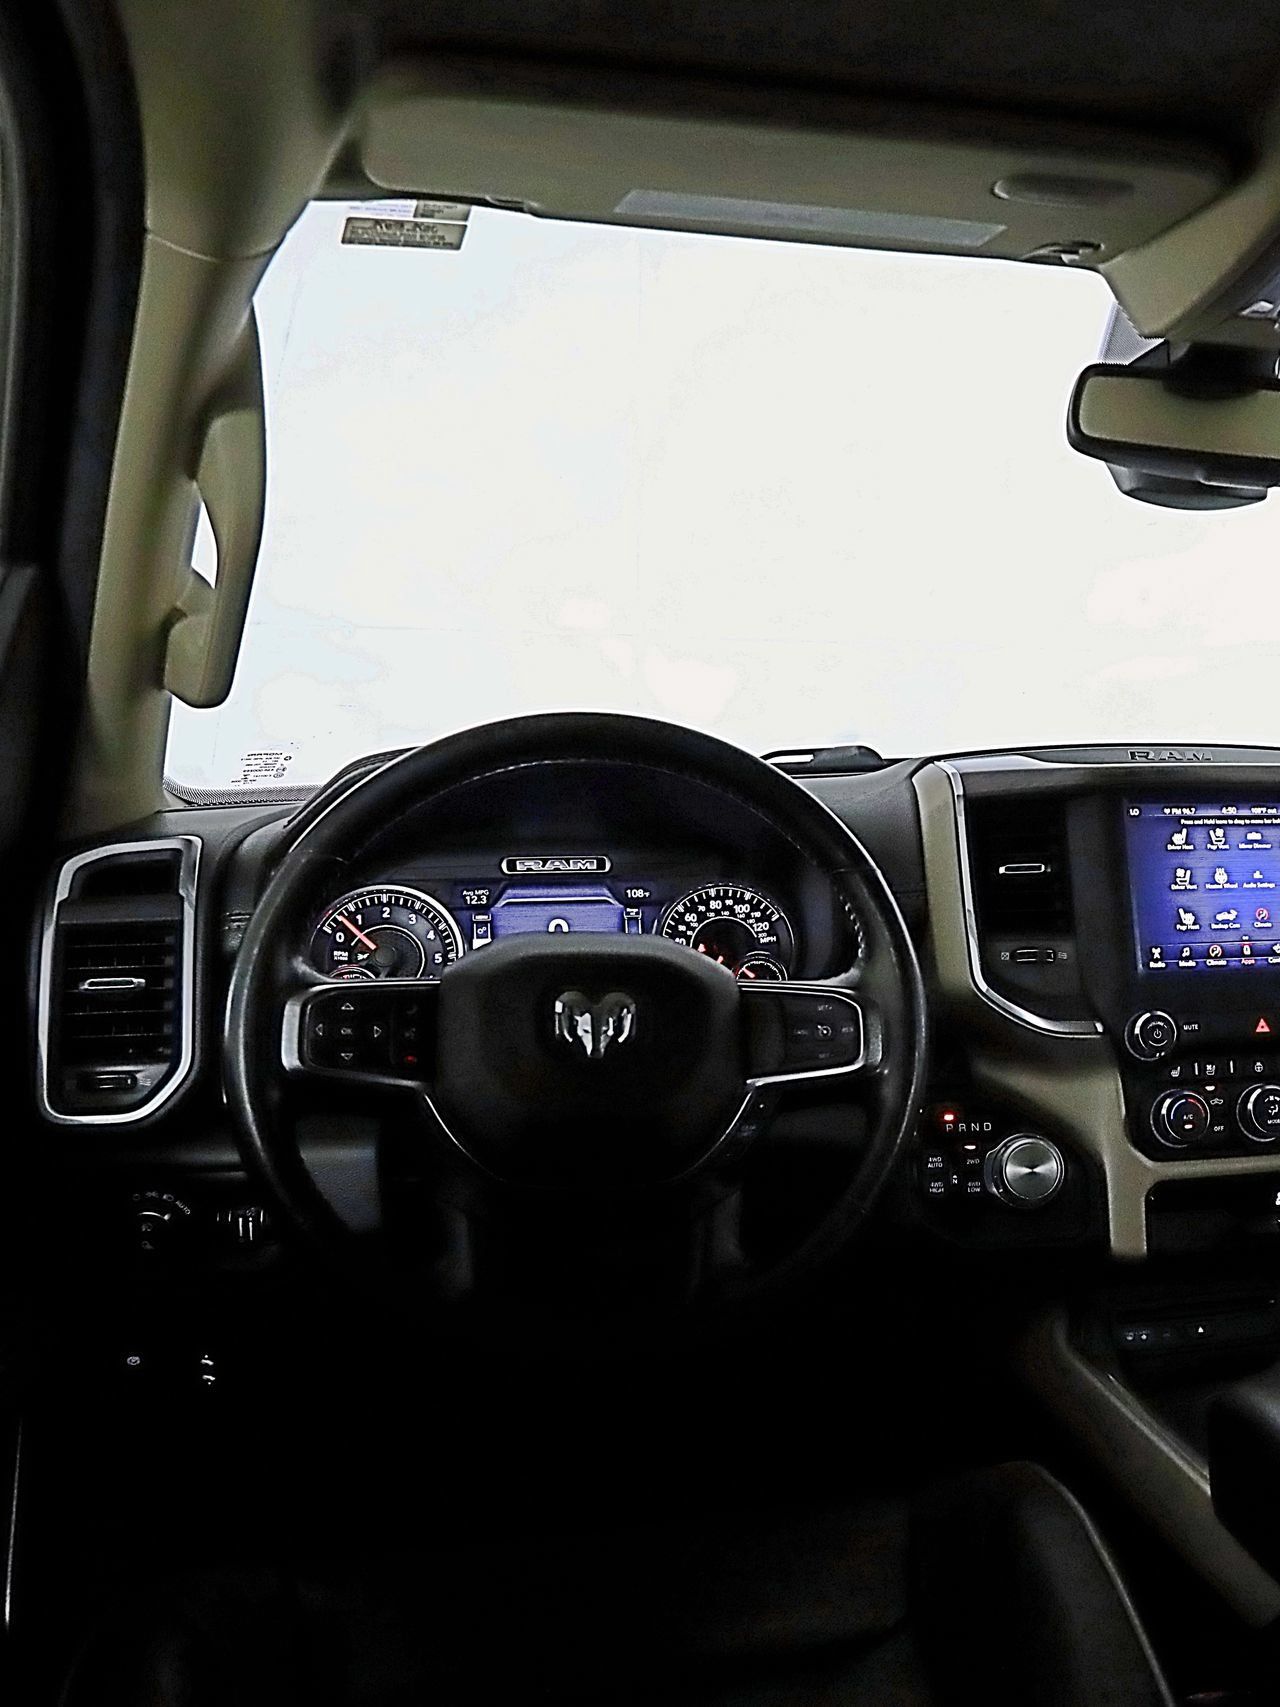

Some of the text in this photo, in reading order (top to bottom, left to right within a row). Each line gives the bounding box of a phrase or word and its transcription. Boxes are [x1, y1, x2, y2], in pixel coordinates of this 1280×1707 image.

[1128, 749, 1213, 762] RAM
[516, 859, 597, 871] RAM
[465, 895, 487, 905] 12.3
[709, 899, 723, 910] 80
[381, 907, 391, 918] 2
[733, 904, 751, 914] 100
[355, 914, 364, 925] 1
[408, 913, 417, 925] 3
[684, 913, 698, 923] 60
[752, 921, 769, 932] 120
[335, 932, 345, 943] 0
[426, 929, 436, 941] 4
[759, 936, 776, 944] MPH
[434, 953, 443, 964] 5
[945, 1122, 992, 1133] P R N D
